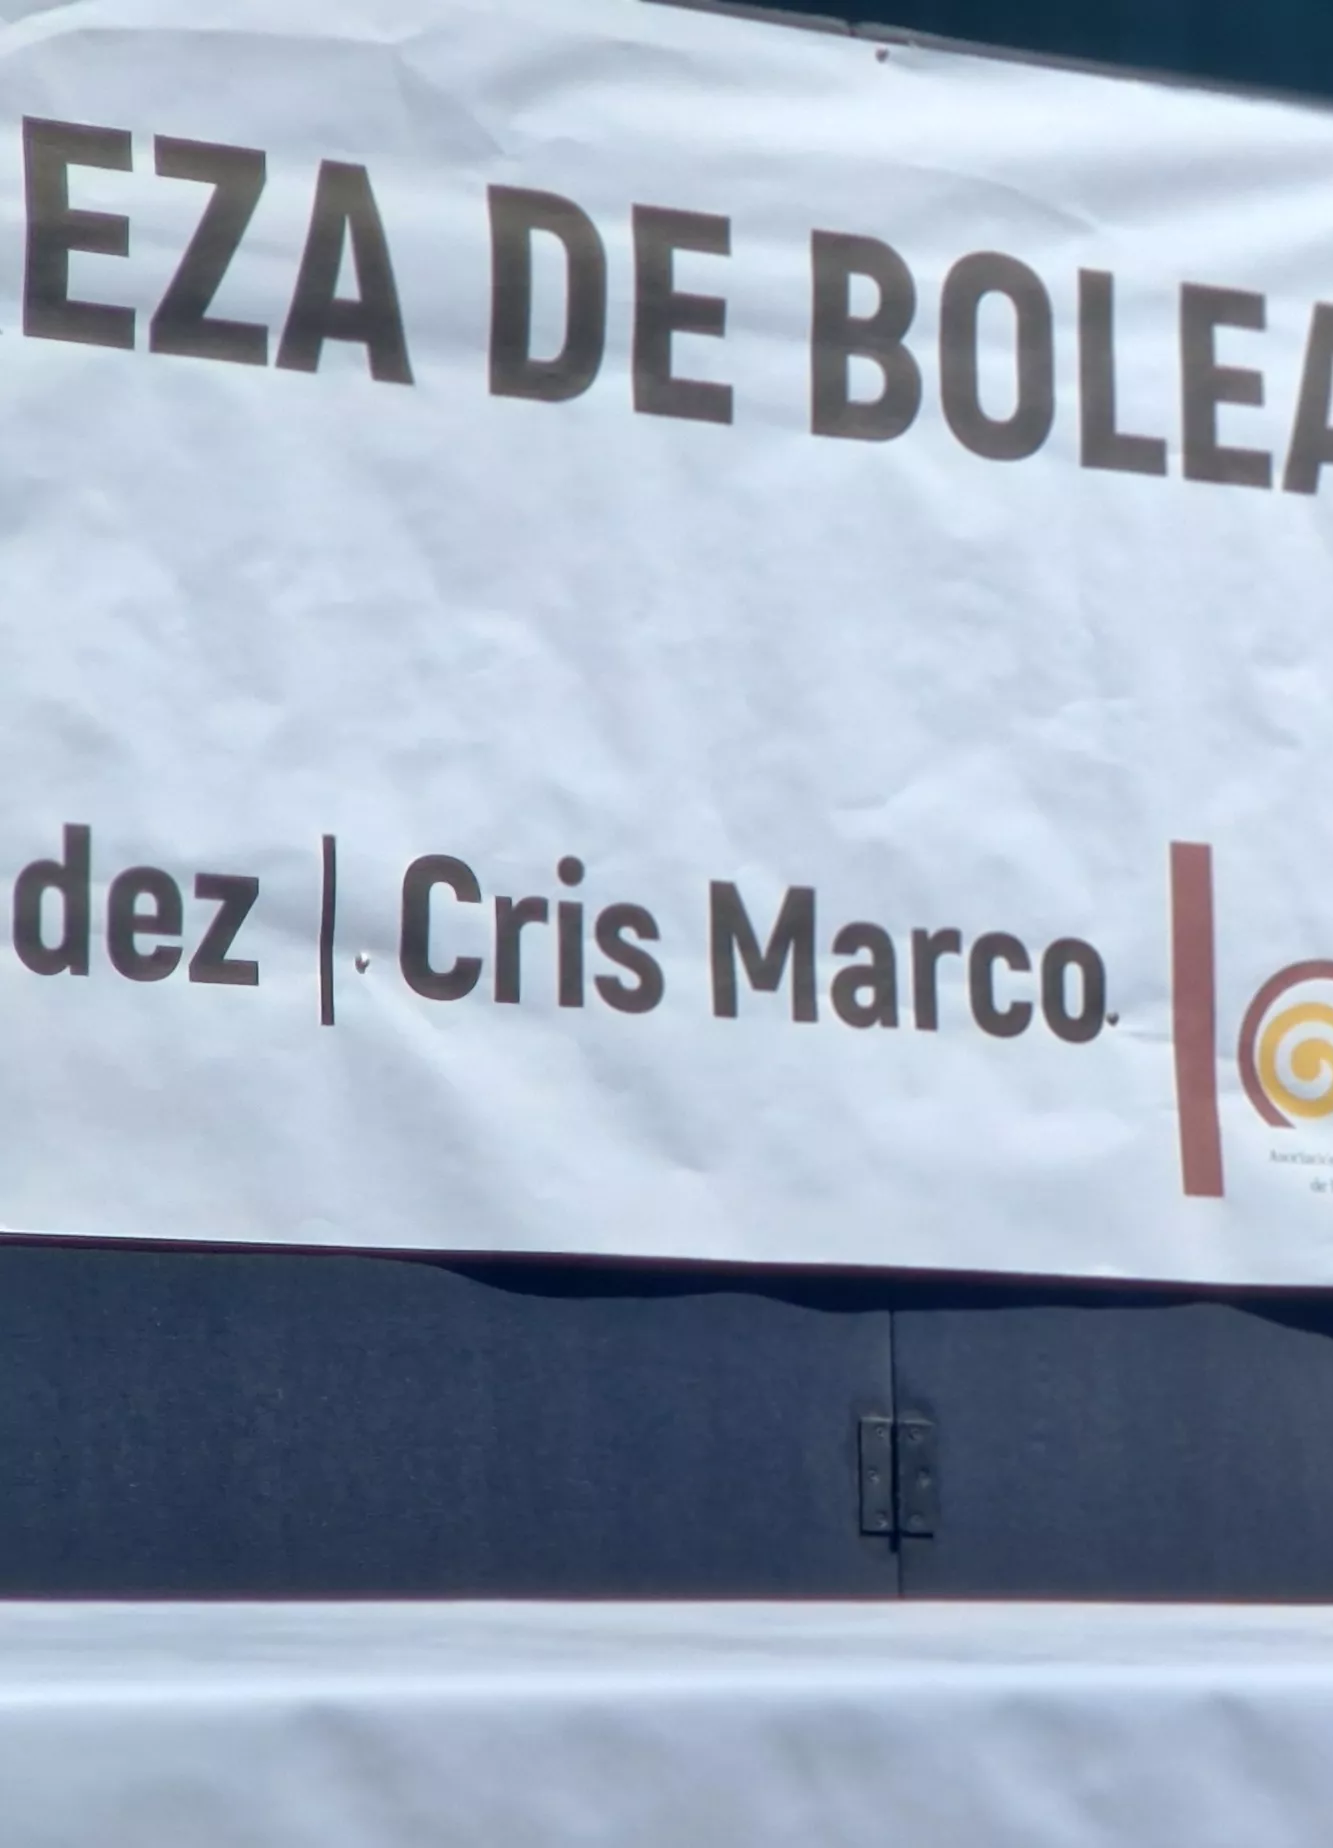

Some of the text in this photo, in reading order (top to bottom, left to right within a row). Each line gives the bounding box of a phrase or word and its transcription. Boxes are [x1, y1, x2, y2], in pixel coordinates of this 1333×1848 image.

[22, 114, 415, 387] EZA
[487, 184, 733, 425] DE
[12, 823, 260, 987] dez
[400, 854, 664, 1014] Cris
[708, 880, 1108, 1044] Marco
